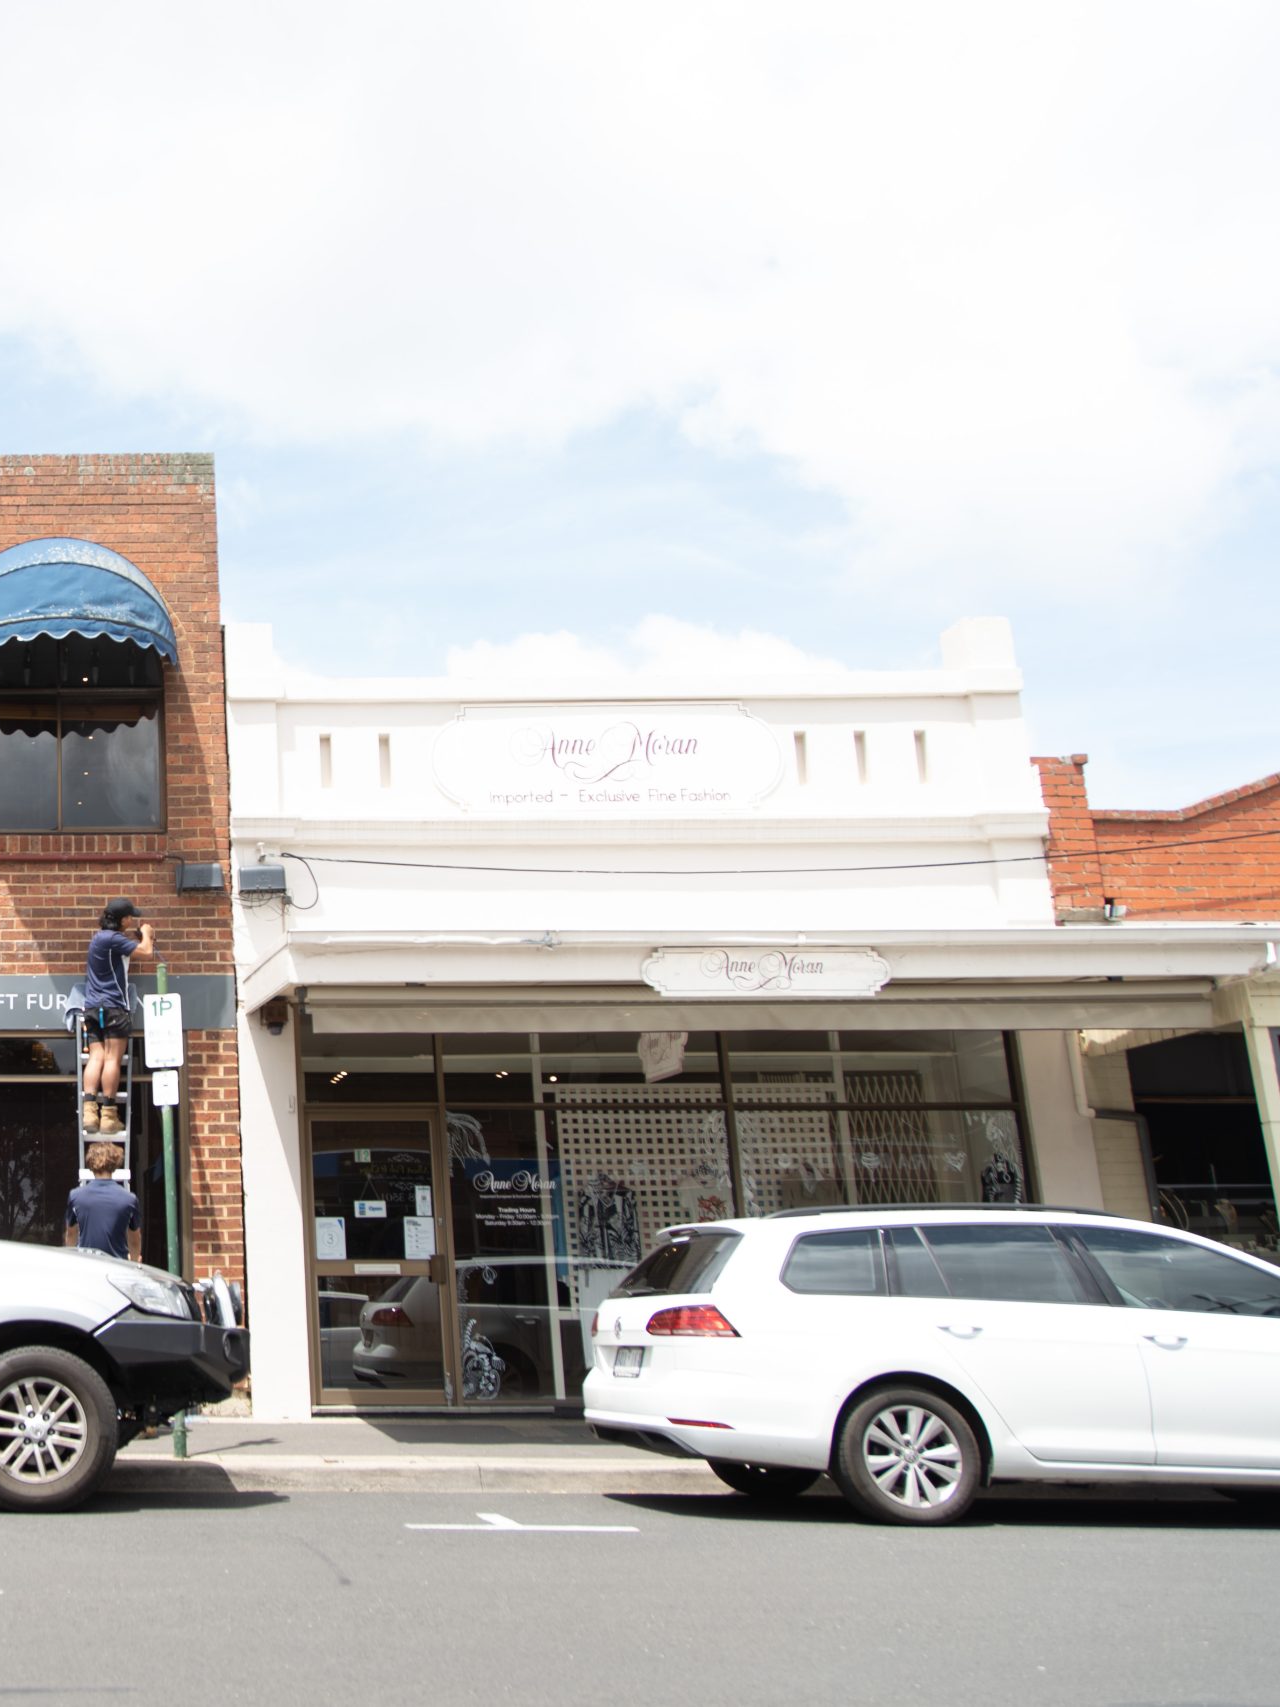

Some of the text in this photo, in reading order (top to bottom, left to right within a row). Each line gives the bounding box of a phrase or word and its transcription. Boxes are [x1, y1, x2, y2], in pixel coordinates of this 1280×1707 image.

[510, 722, 698, 770] Anne Moran
[489, 790, 553, 806] Imported
[579, 789, 640, 803] Exclusive
[648, 788, 677, 802] Fine
[680, 788, 731, 803] Fashion
[701, 950, 823, 981] Anne Moran
[152, 1000, 172, 1016] 1P
[473, 1170, 556, 1193] Anne Moran
